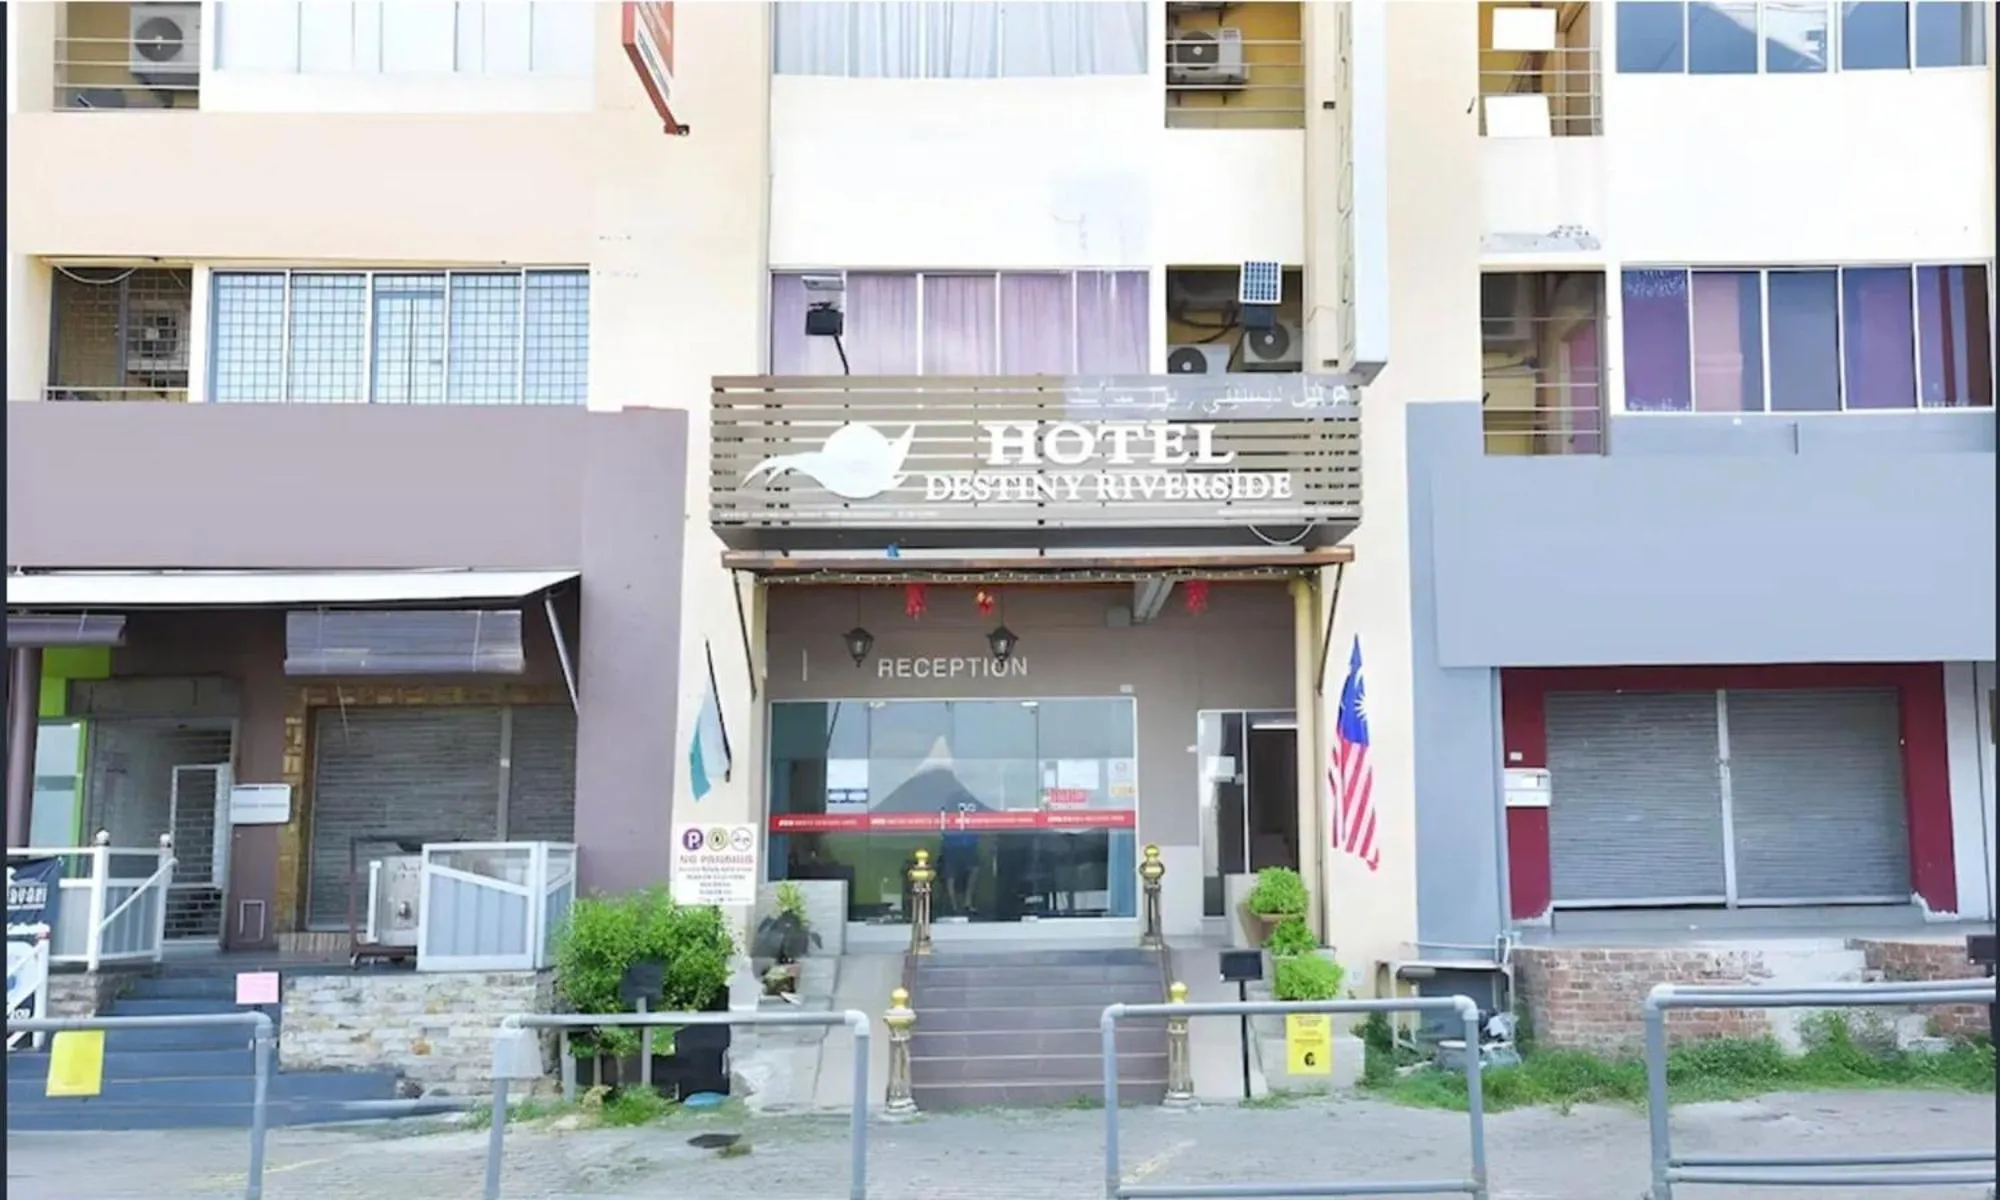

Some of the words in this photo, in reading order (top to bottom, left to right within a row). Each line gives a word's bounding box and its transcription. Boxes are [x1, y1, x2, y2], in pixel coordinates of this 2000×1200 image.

[983, 423, 1235, 466] HOTEL
[925, 473, 1089, 501] DESTINY
[1098, 472, 1293, 501] RIVERSIDE
[876, 656, 1028, 678] RECEPTION
